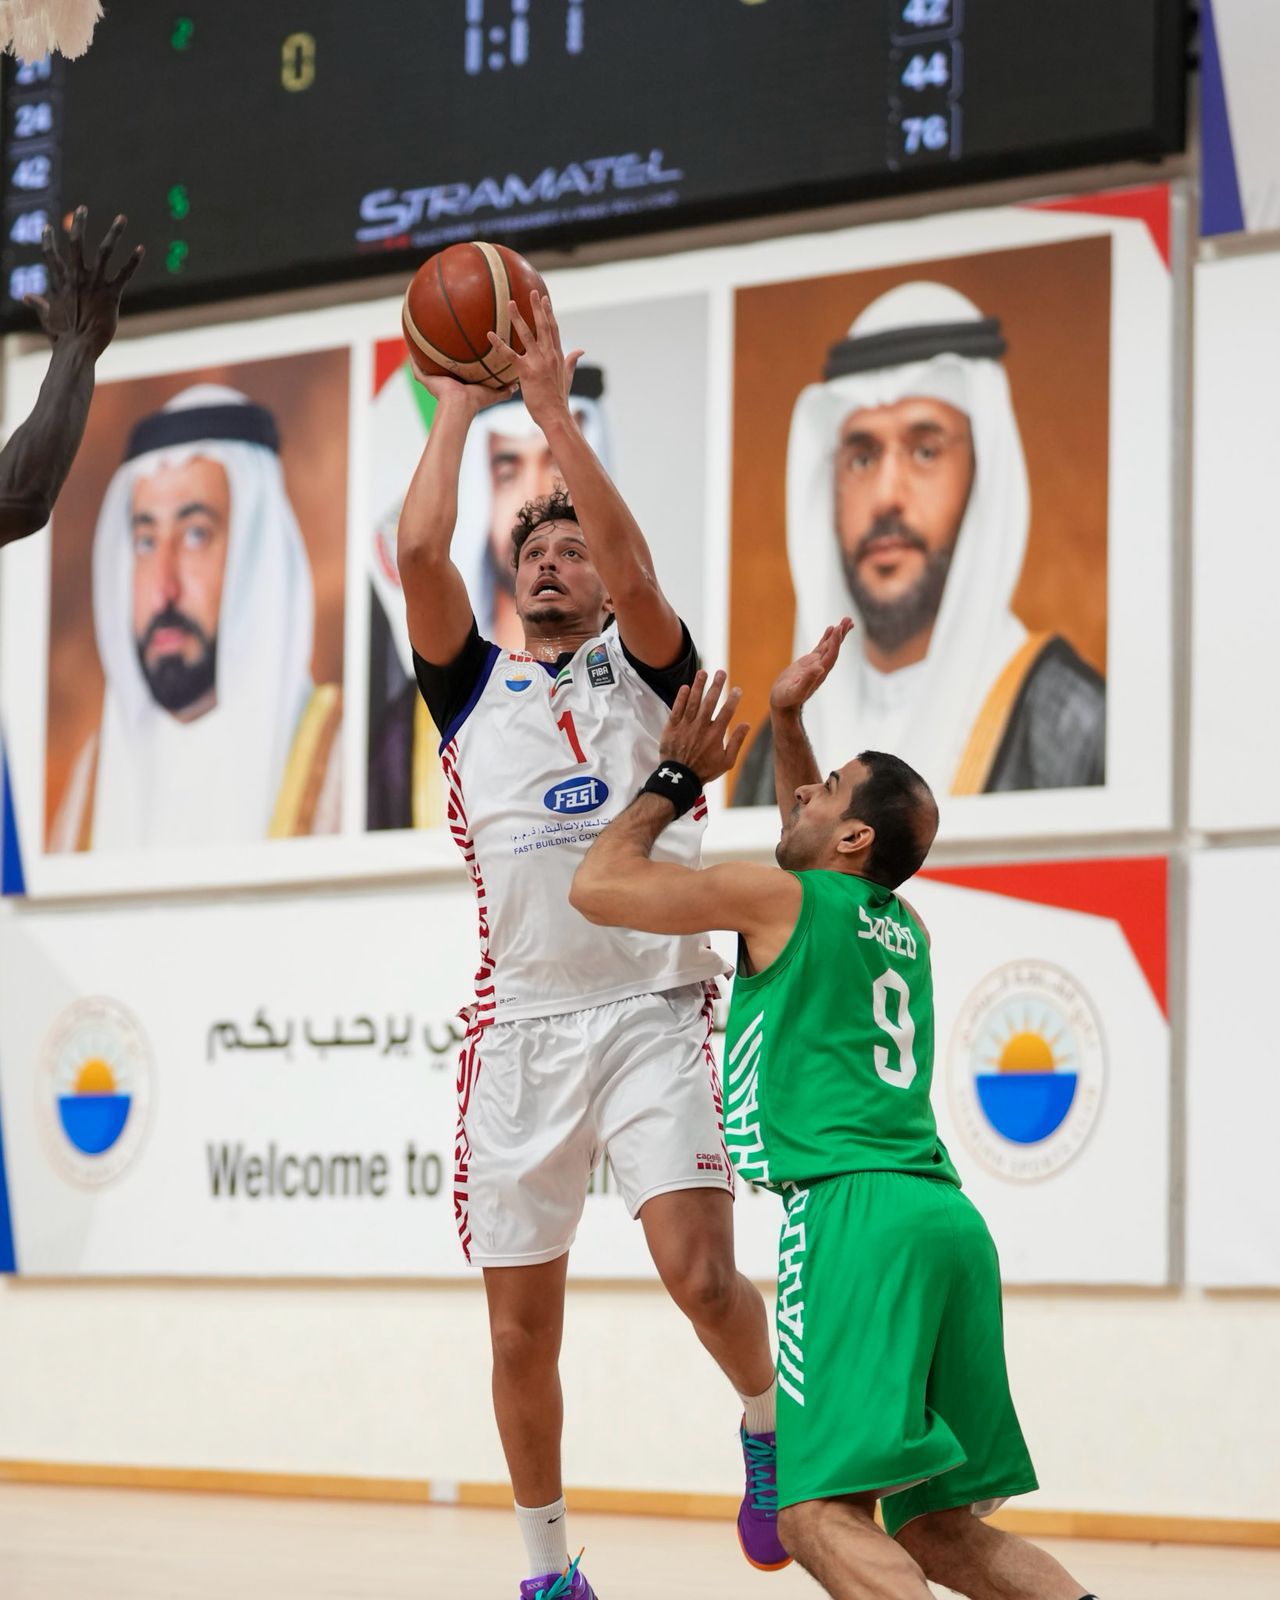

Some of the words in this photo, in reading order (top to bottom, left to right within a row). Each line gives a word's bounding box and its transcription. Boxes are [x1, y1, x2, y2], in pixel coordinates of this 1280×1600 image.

[281, 32, 316, 92] 0
[901, 50, 949, 92] 44
[901, 114, 949, 155] 76
[355, 148, 684, 242] STRAMATEL
[591, 665, 609, 678] FIBA
[557, 710, 587, 764] 1
[553, 779, 600, 810] Fast
[513, 843, 533, 855] FAST
[535, 837, 577, 850] BUILDING
[579, 831, 602, 842] CON
[857, 904, 917, 960] SAEED
[206, 1005, 294, 1062] بكم
[302, 1012, 413, 1061] يرحب
[872, 967, 917, 1089] 9
[206, 1140, 390, 1198] Welcome
[405, 1140, 444, 1198] to
